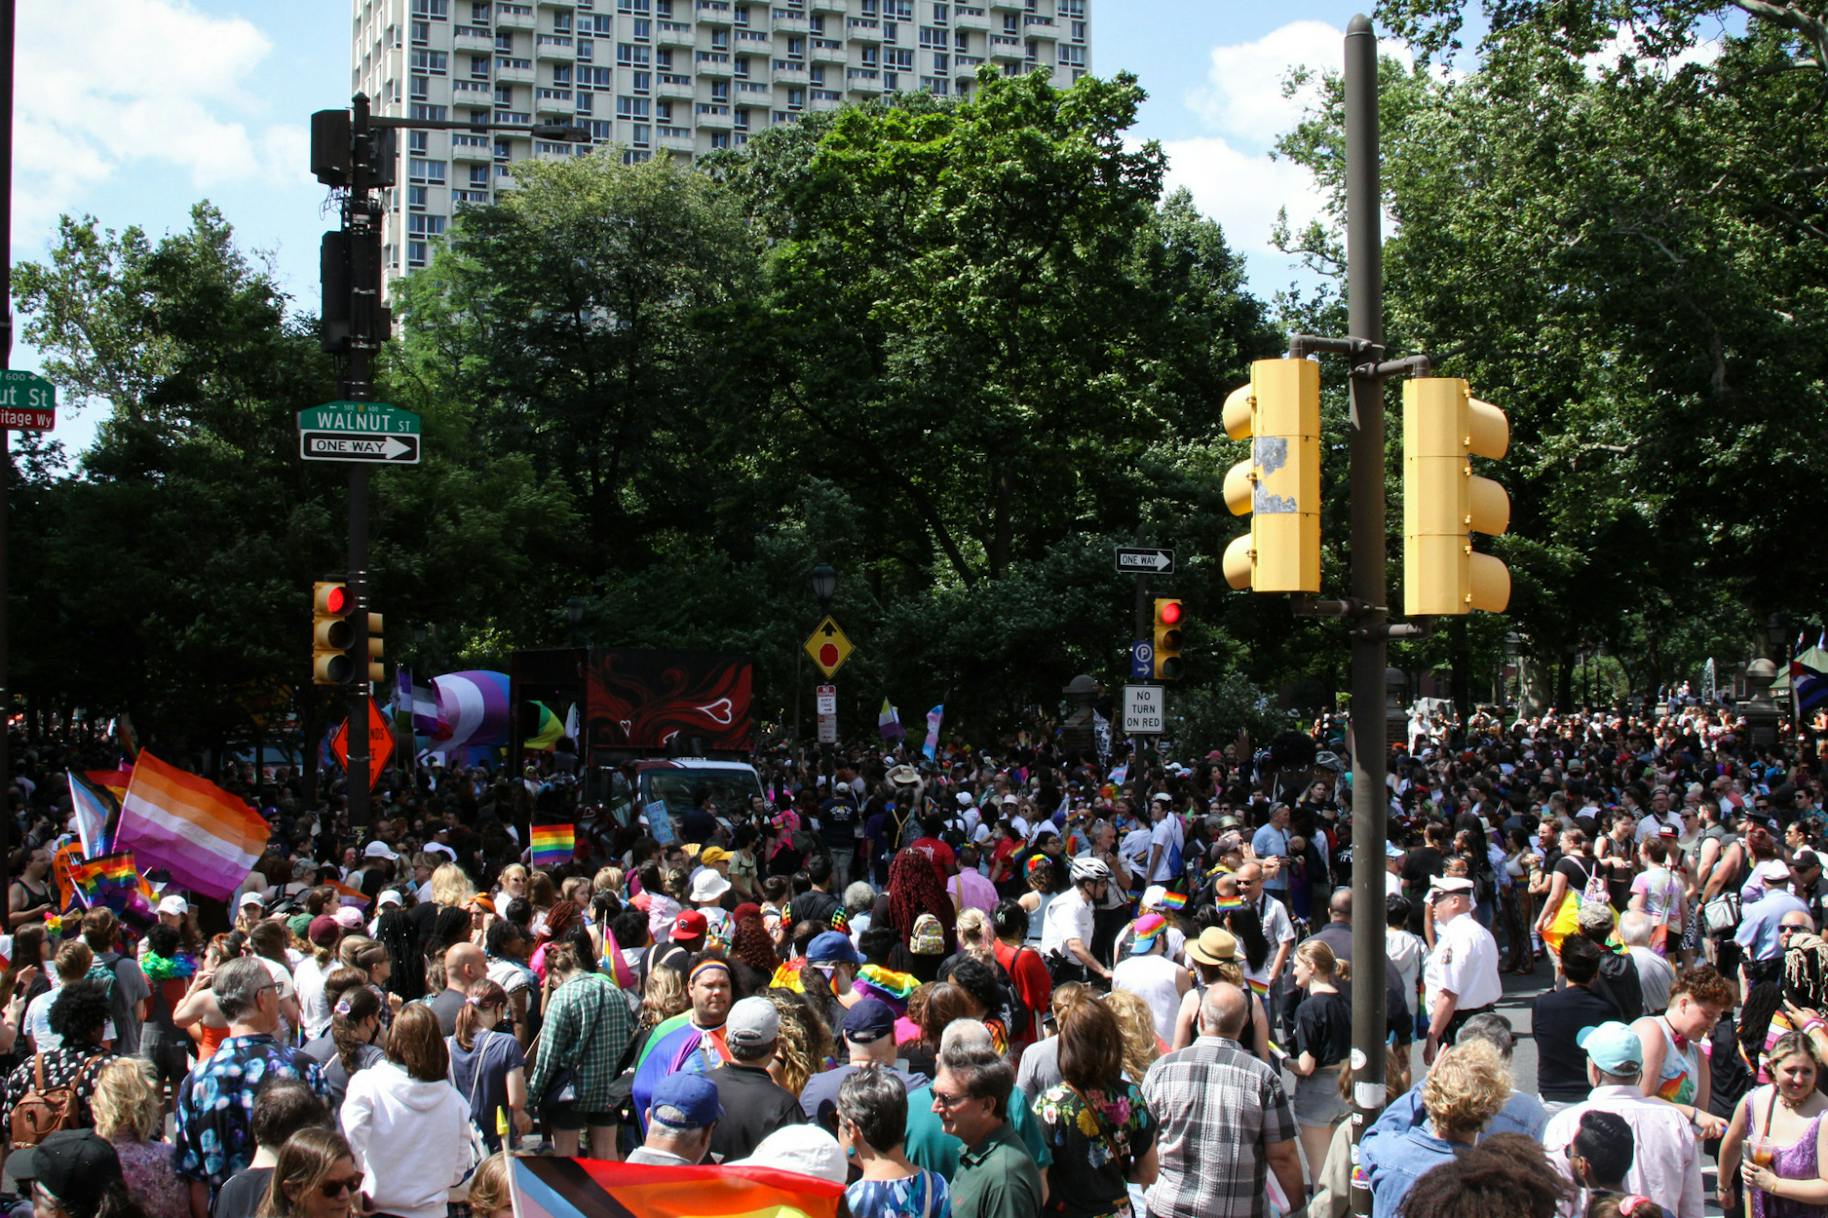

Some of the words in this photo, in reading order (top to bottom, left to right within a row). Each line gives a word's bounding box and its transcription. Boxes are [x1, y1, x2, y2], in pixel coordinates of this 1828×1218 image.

[29, 388, 48, 407] St
[36, 413, 52, 428] Wy
[317, 412, 391, 432] WALNUT
[398, 420, 411, 433] ST
[316, 440, 347, 452] ONE
[352, 441, 385, 453] WAY
[1121, 554, 1139, 565] ONE
[1140, 555, 1158, 565] WAY
[1136, 691, 1151, 701] NO
[1132, 704, 1155, 714] TURN
[1127, 717, 1139, 727] ON
[1142, 717, 1160, 728] RED
